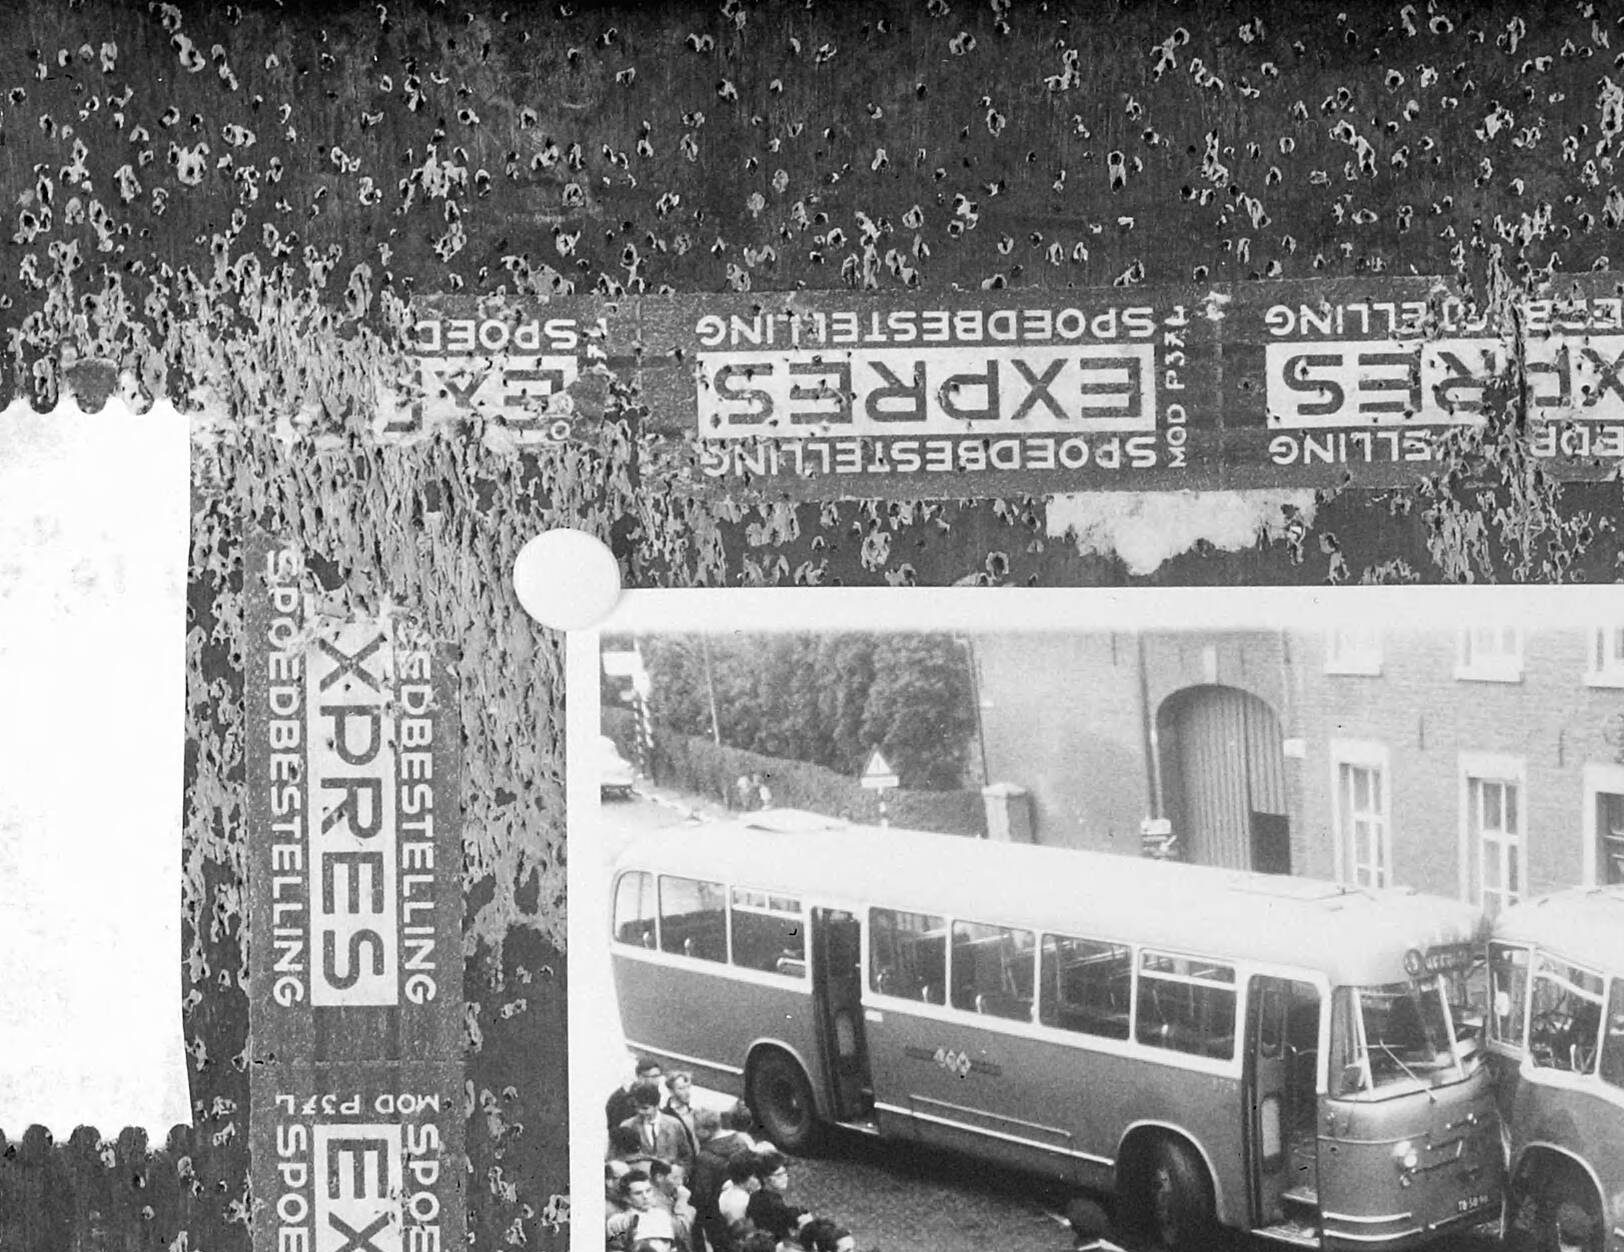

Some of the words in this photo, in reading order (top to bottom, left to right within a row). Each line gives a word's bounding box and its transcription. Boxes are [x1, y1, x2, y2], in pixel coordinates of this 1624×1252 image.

[700, 305, 1155, 346] SPOEDBESTELLING
[711, 355, 1141, 424] EXPRES
[701, 436, 1157, 477] SPOEDBESTELLING
[1166, 404, 1187, 468] MOD
[318, 634, 384, 991] XPRES
[401, 650, 437, 1006] EDBESTELLING
[375, 1094, 439, 1113] MOD
